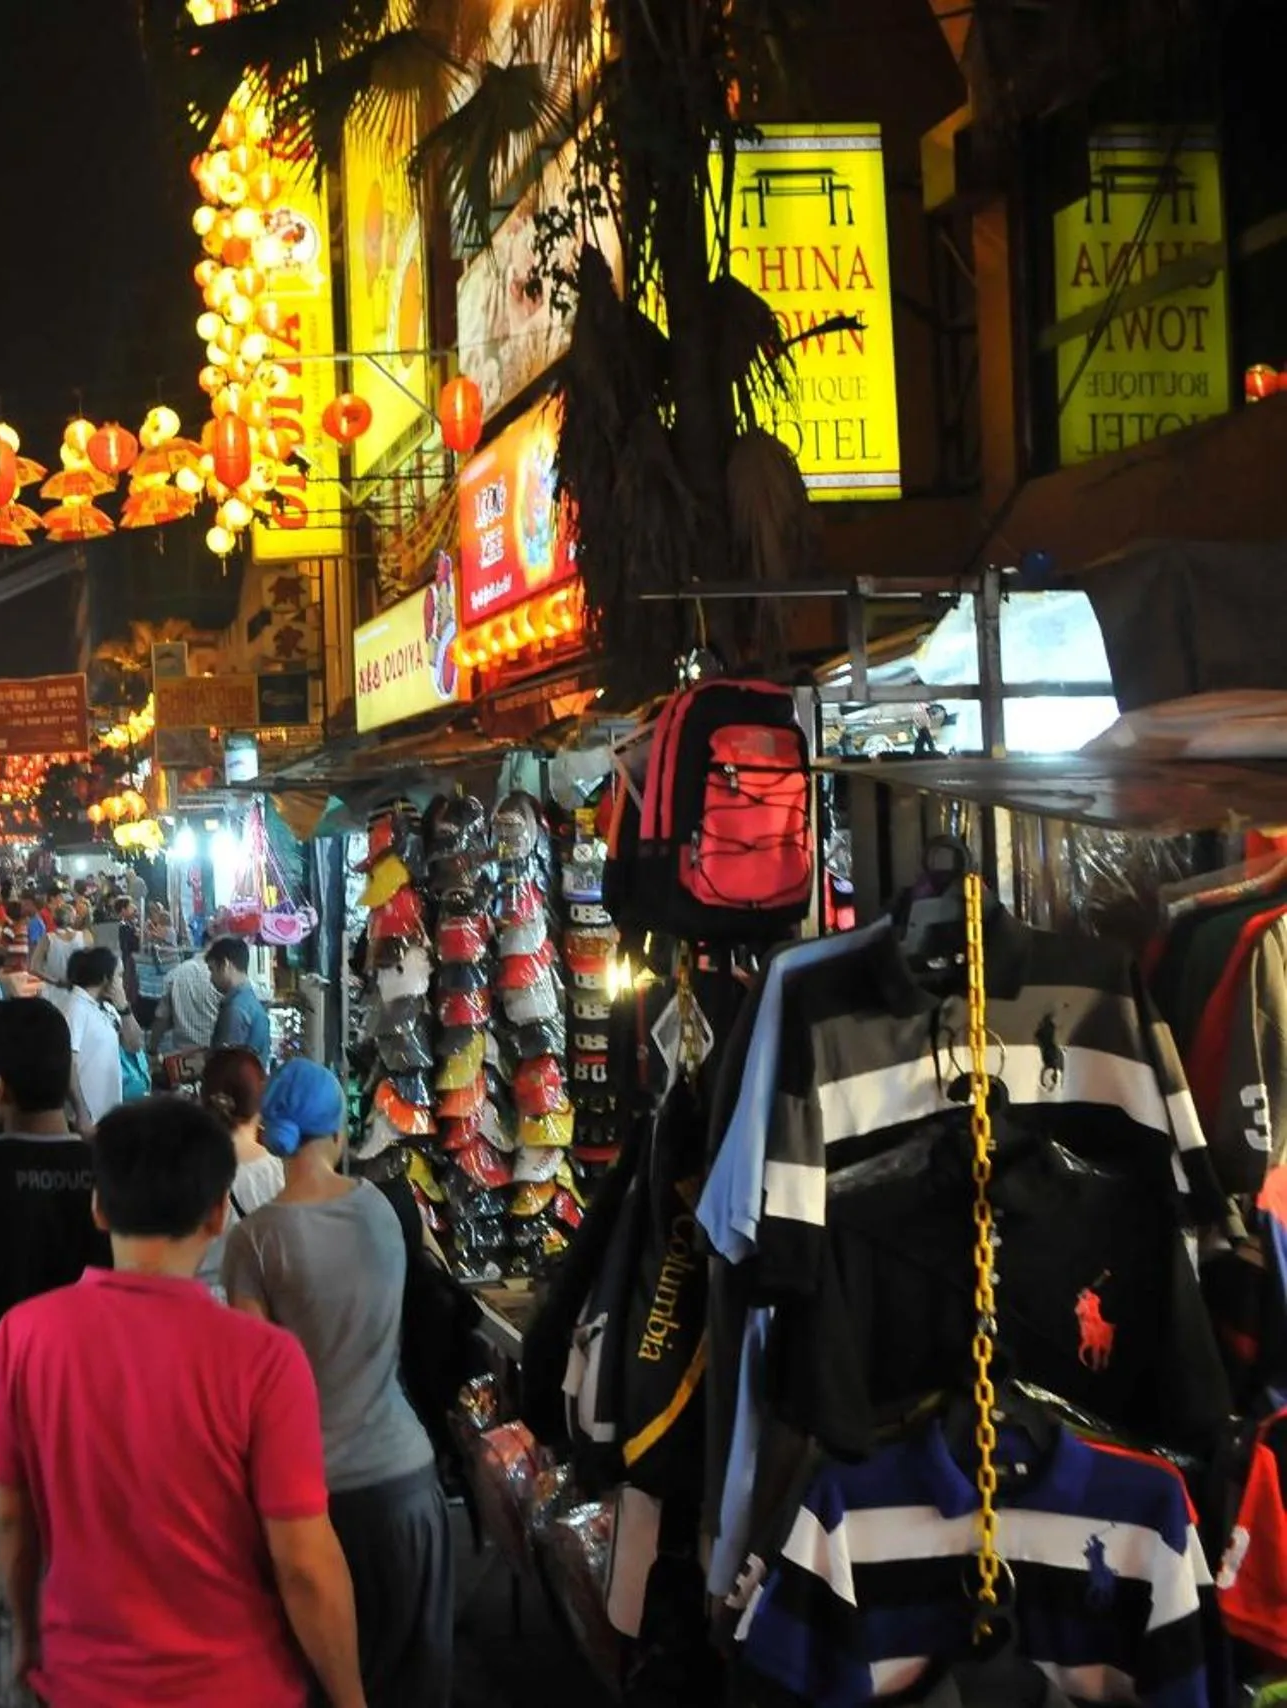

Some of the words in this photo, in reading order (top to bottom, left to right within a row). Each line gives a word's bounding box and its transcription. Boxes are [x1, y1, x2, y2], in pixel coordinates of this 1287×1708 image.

[778, 417, 881, 461] OTEL
[16, 1168, 93, 1191] PRODUC
[638, 1213, 698, 1361] Columbia
